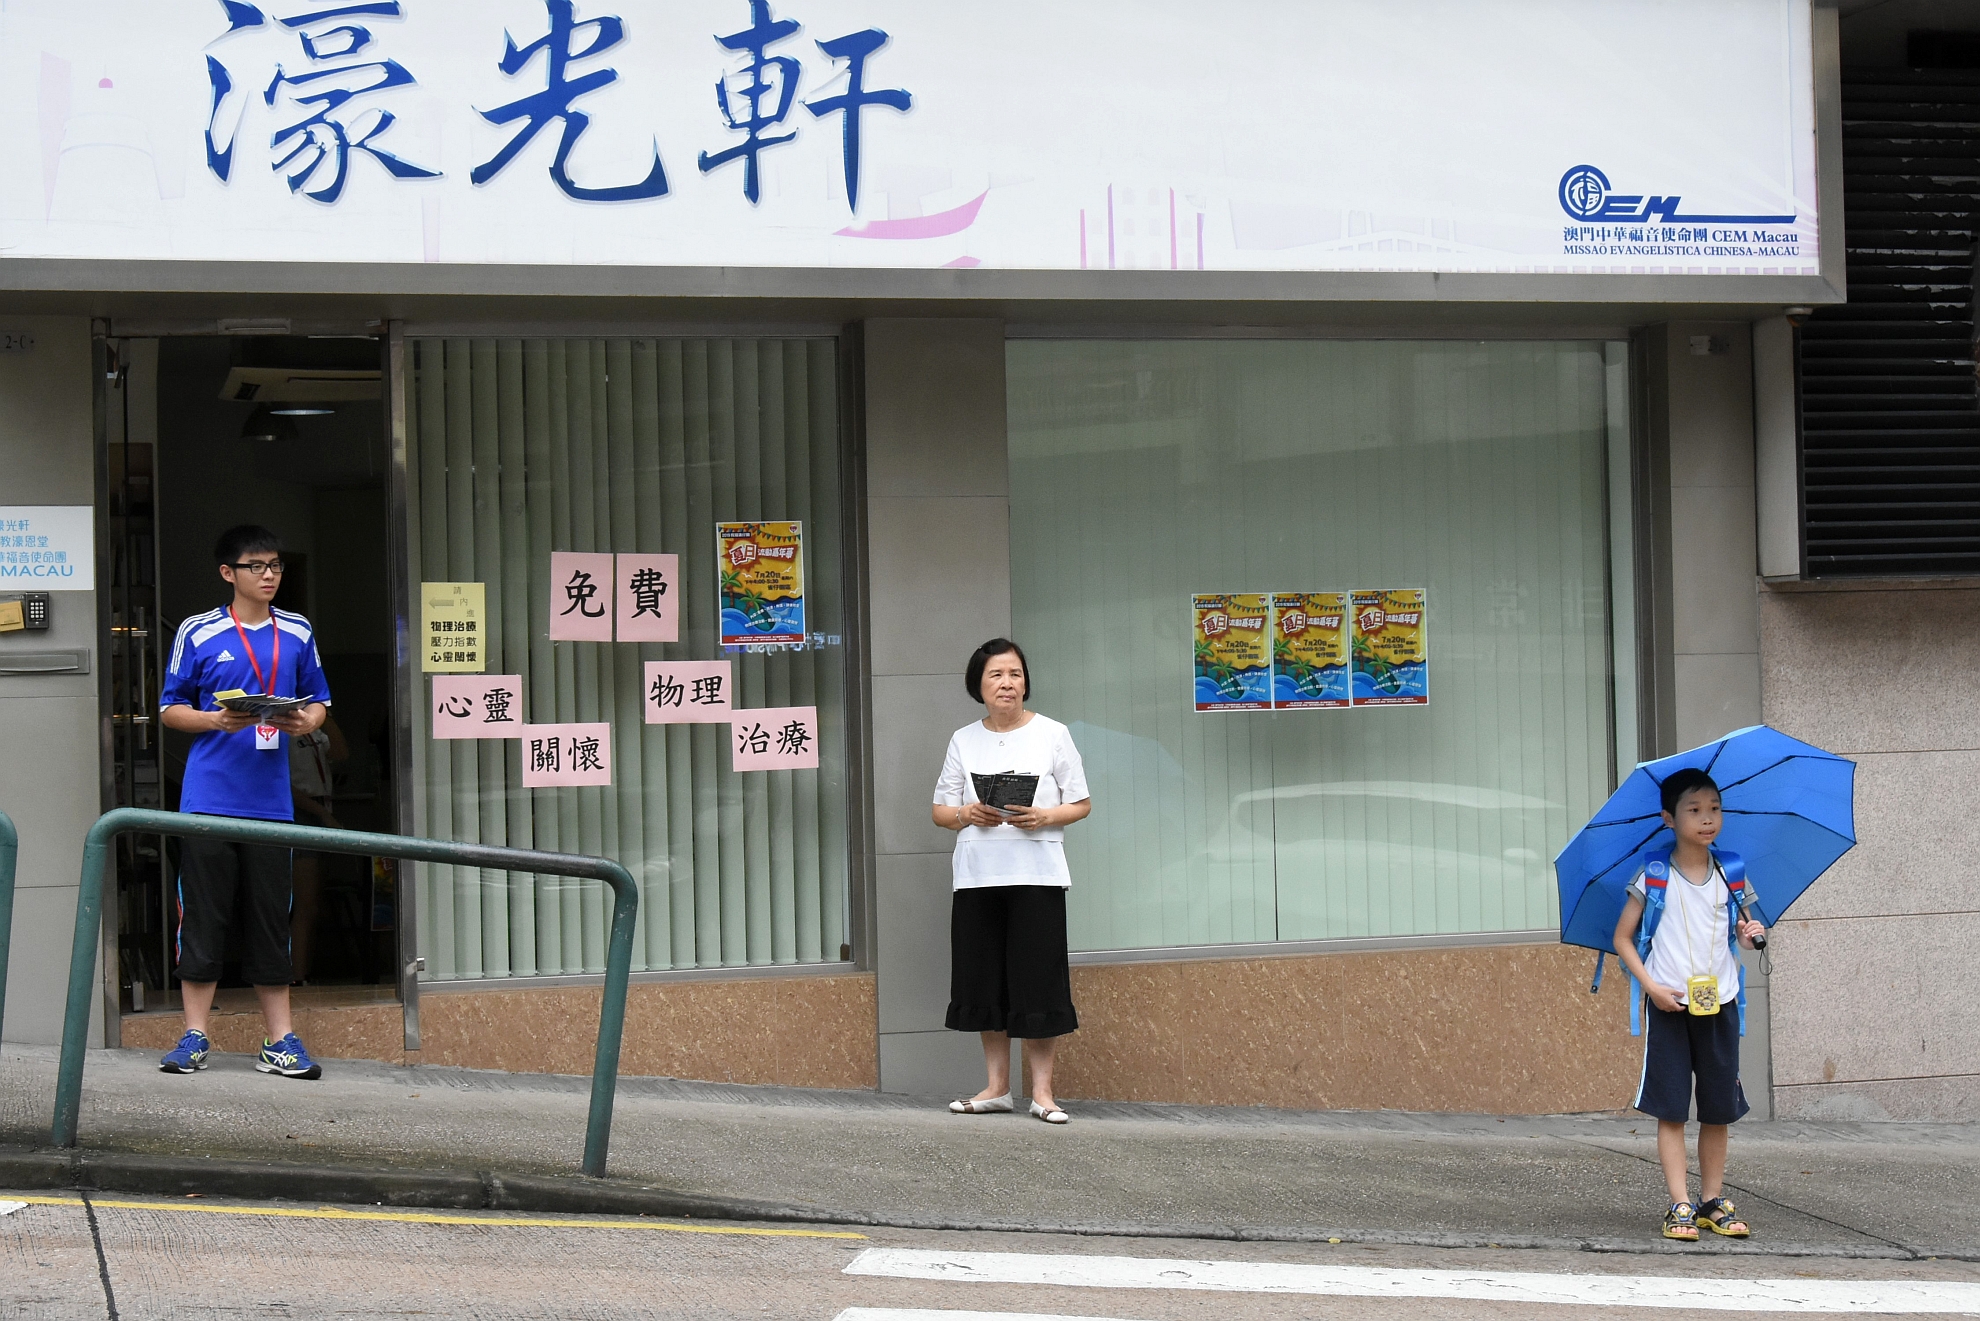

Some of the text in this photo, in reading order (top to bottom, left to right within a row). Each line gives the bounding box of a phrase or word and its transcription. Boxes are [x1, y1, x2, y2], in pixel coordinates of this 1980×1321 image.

[202, 0, 914, 214] 濠光軒
[1563, 226, 1798, 243] 澳門中華福音使命團 CEM Macau
[1703, 246, 1800, 256] CHINESA-MACAU
[1, 565, 74, 577] MACAU
[560, 568, 668, 619] 免費
[430, 621, 477, 632] 物理治療
[430, 636, 477, 647] 壓力指數
[438, 687, 515, 723] 心靈
[649, 673, 724, 708] 物理
[530, 736, 605, 773] 關懷
[737, 719, 812, 756] 治療
